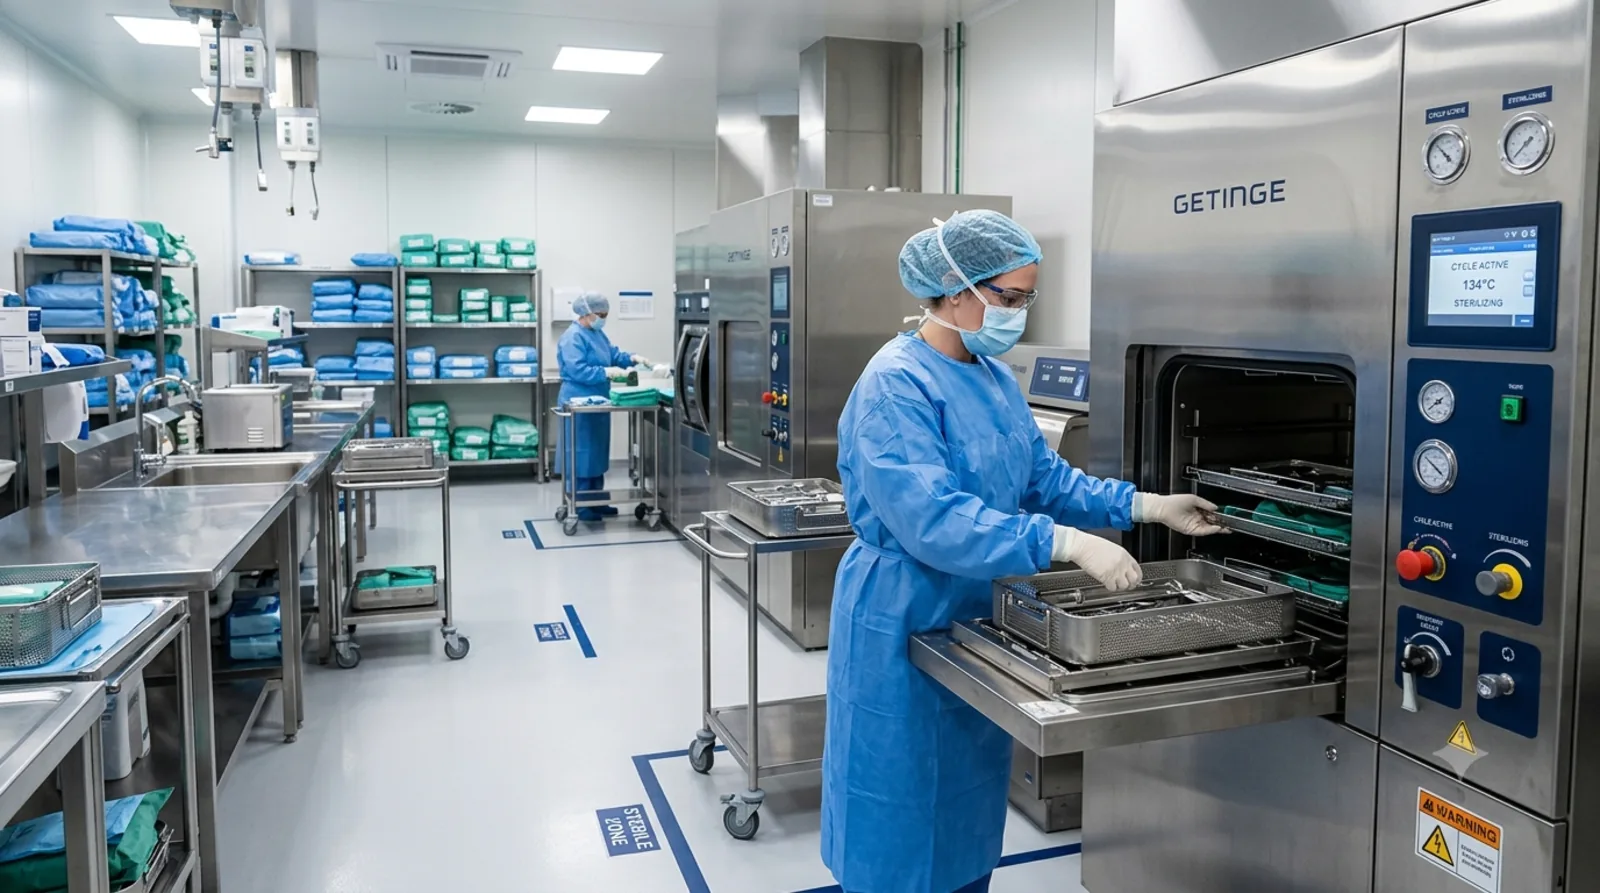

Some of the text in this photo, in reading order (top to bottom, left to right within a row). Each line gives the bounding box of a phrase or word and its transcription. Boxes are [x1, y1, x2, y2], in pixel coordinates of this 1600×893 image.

[1174, 179, 1286, 214] GETINGE
[1478, 259, 1509, 270] ACTIVE
[1463, 278, 1495, 291] 134°C
[1436, 803, 1497, 844] WARNING
